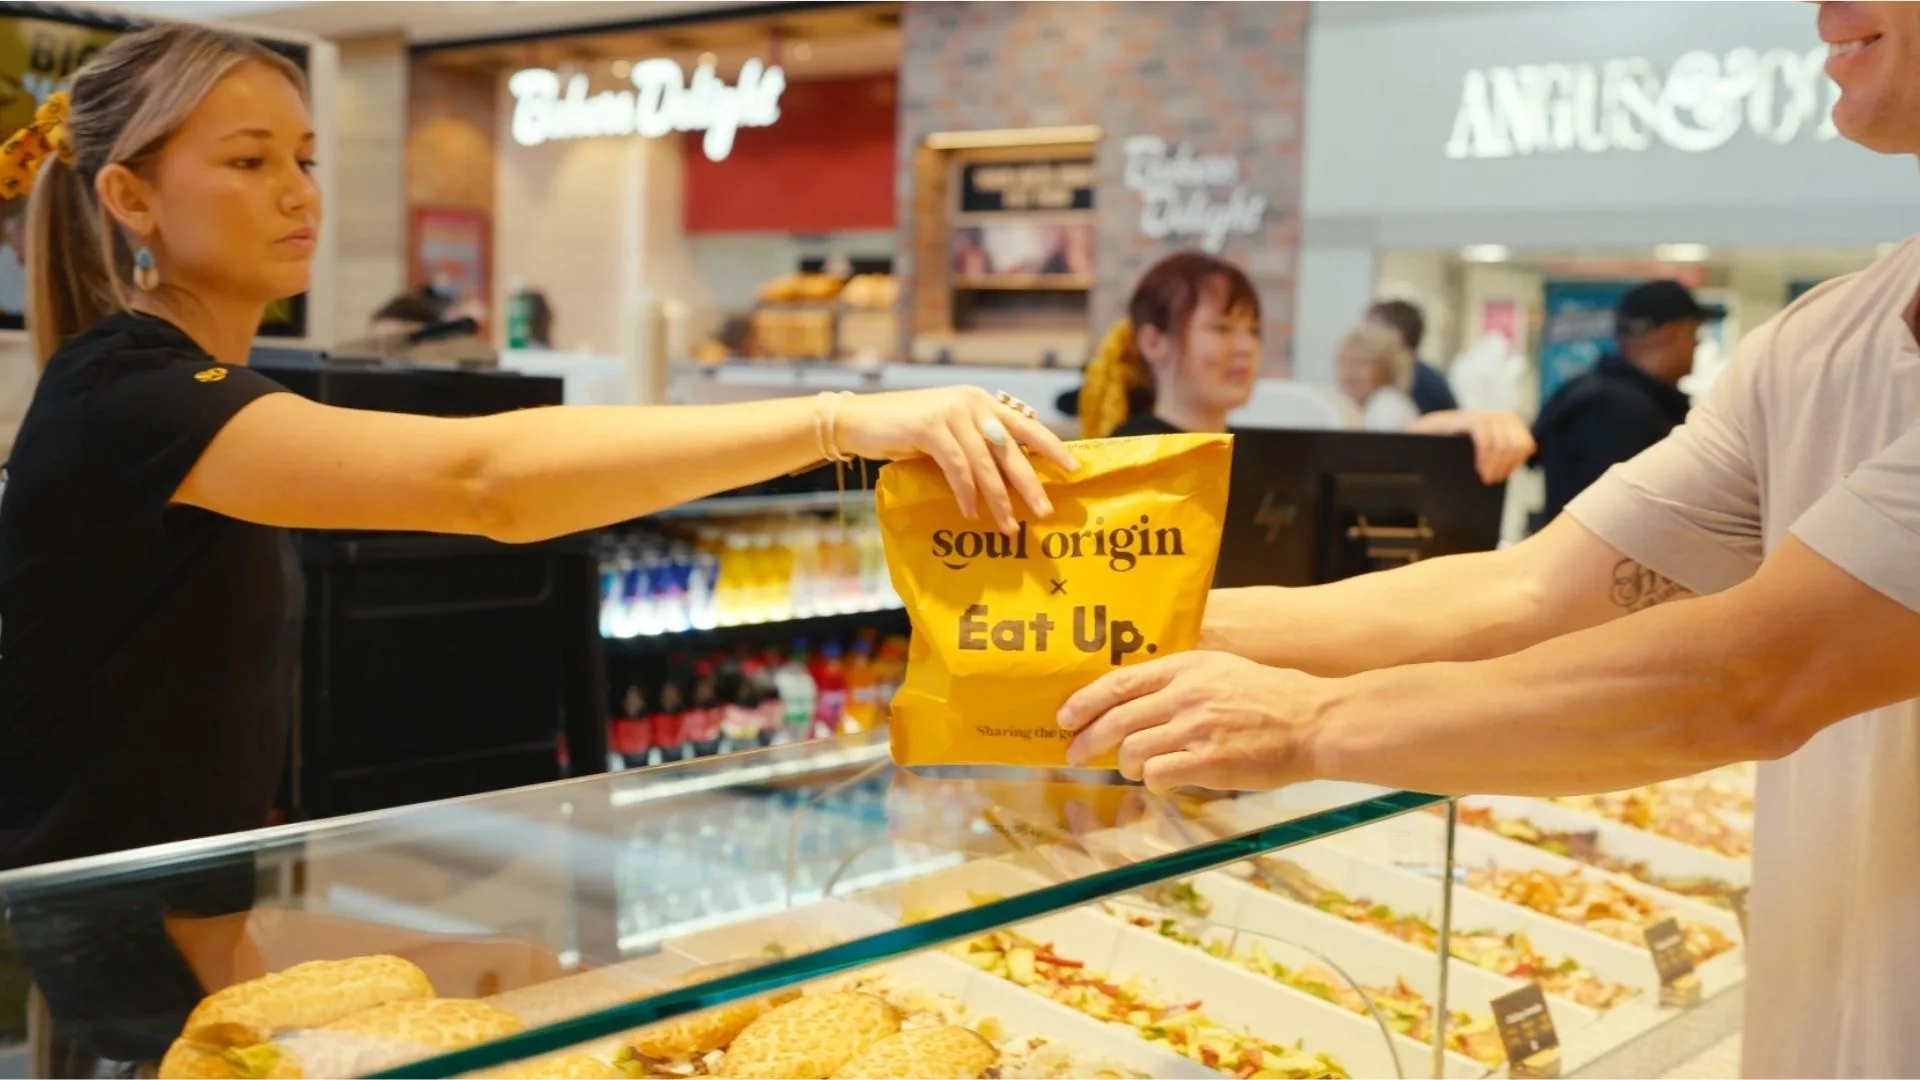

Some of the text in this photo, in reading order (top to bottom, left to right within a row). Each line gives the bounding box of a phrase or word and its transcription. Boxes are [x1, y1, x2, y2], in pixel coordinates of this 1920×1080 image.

[932, 514, 1186, 572] soul origin
[958, 604, 1158, 666] Eat Up.
[977, 725, 1032, 742] Sharing
[1034, 727, 1057, 738] the
